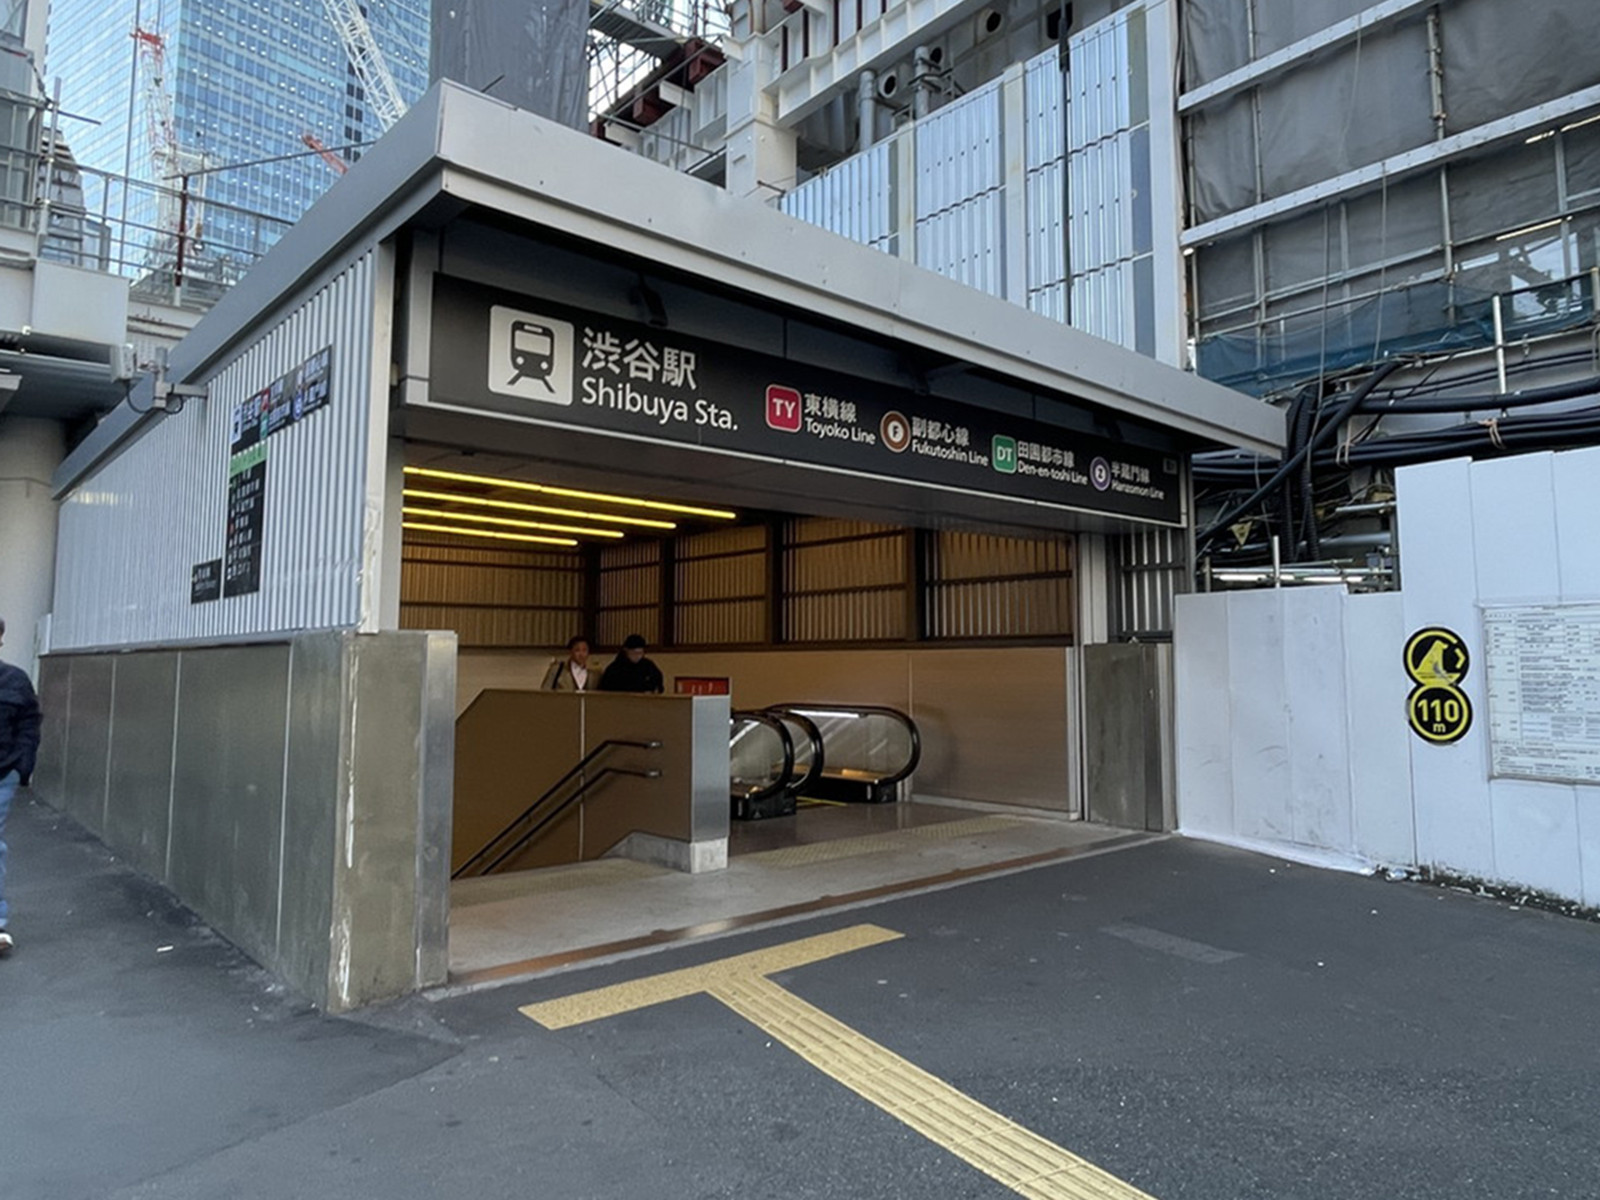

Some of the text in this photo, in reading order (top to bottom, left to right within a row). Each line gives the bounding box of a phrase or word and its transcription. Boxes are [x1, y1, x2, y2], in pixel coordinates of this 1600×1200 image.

[582, 327, 697, 390] 渋谷駅
[581, 377, 738, 431] Shibuya Sta.
[772, 398, 796, 418] TY
[804, 393, 858, 423] 東横線
[805, 417, 876, 445] Toyoko Line
[912, 416, 970, 446] 副都心線
[912, 439, 989, 467] Fukutoshin Line
[997, 446, 1013, 462] DT
[1018, 460, 1088, 485] Den-en-toshi Line
[1417, 698, 1459, 722] 110
[1433, 723, 1446, 733] m
